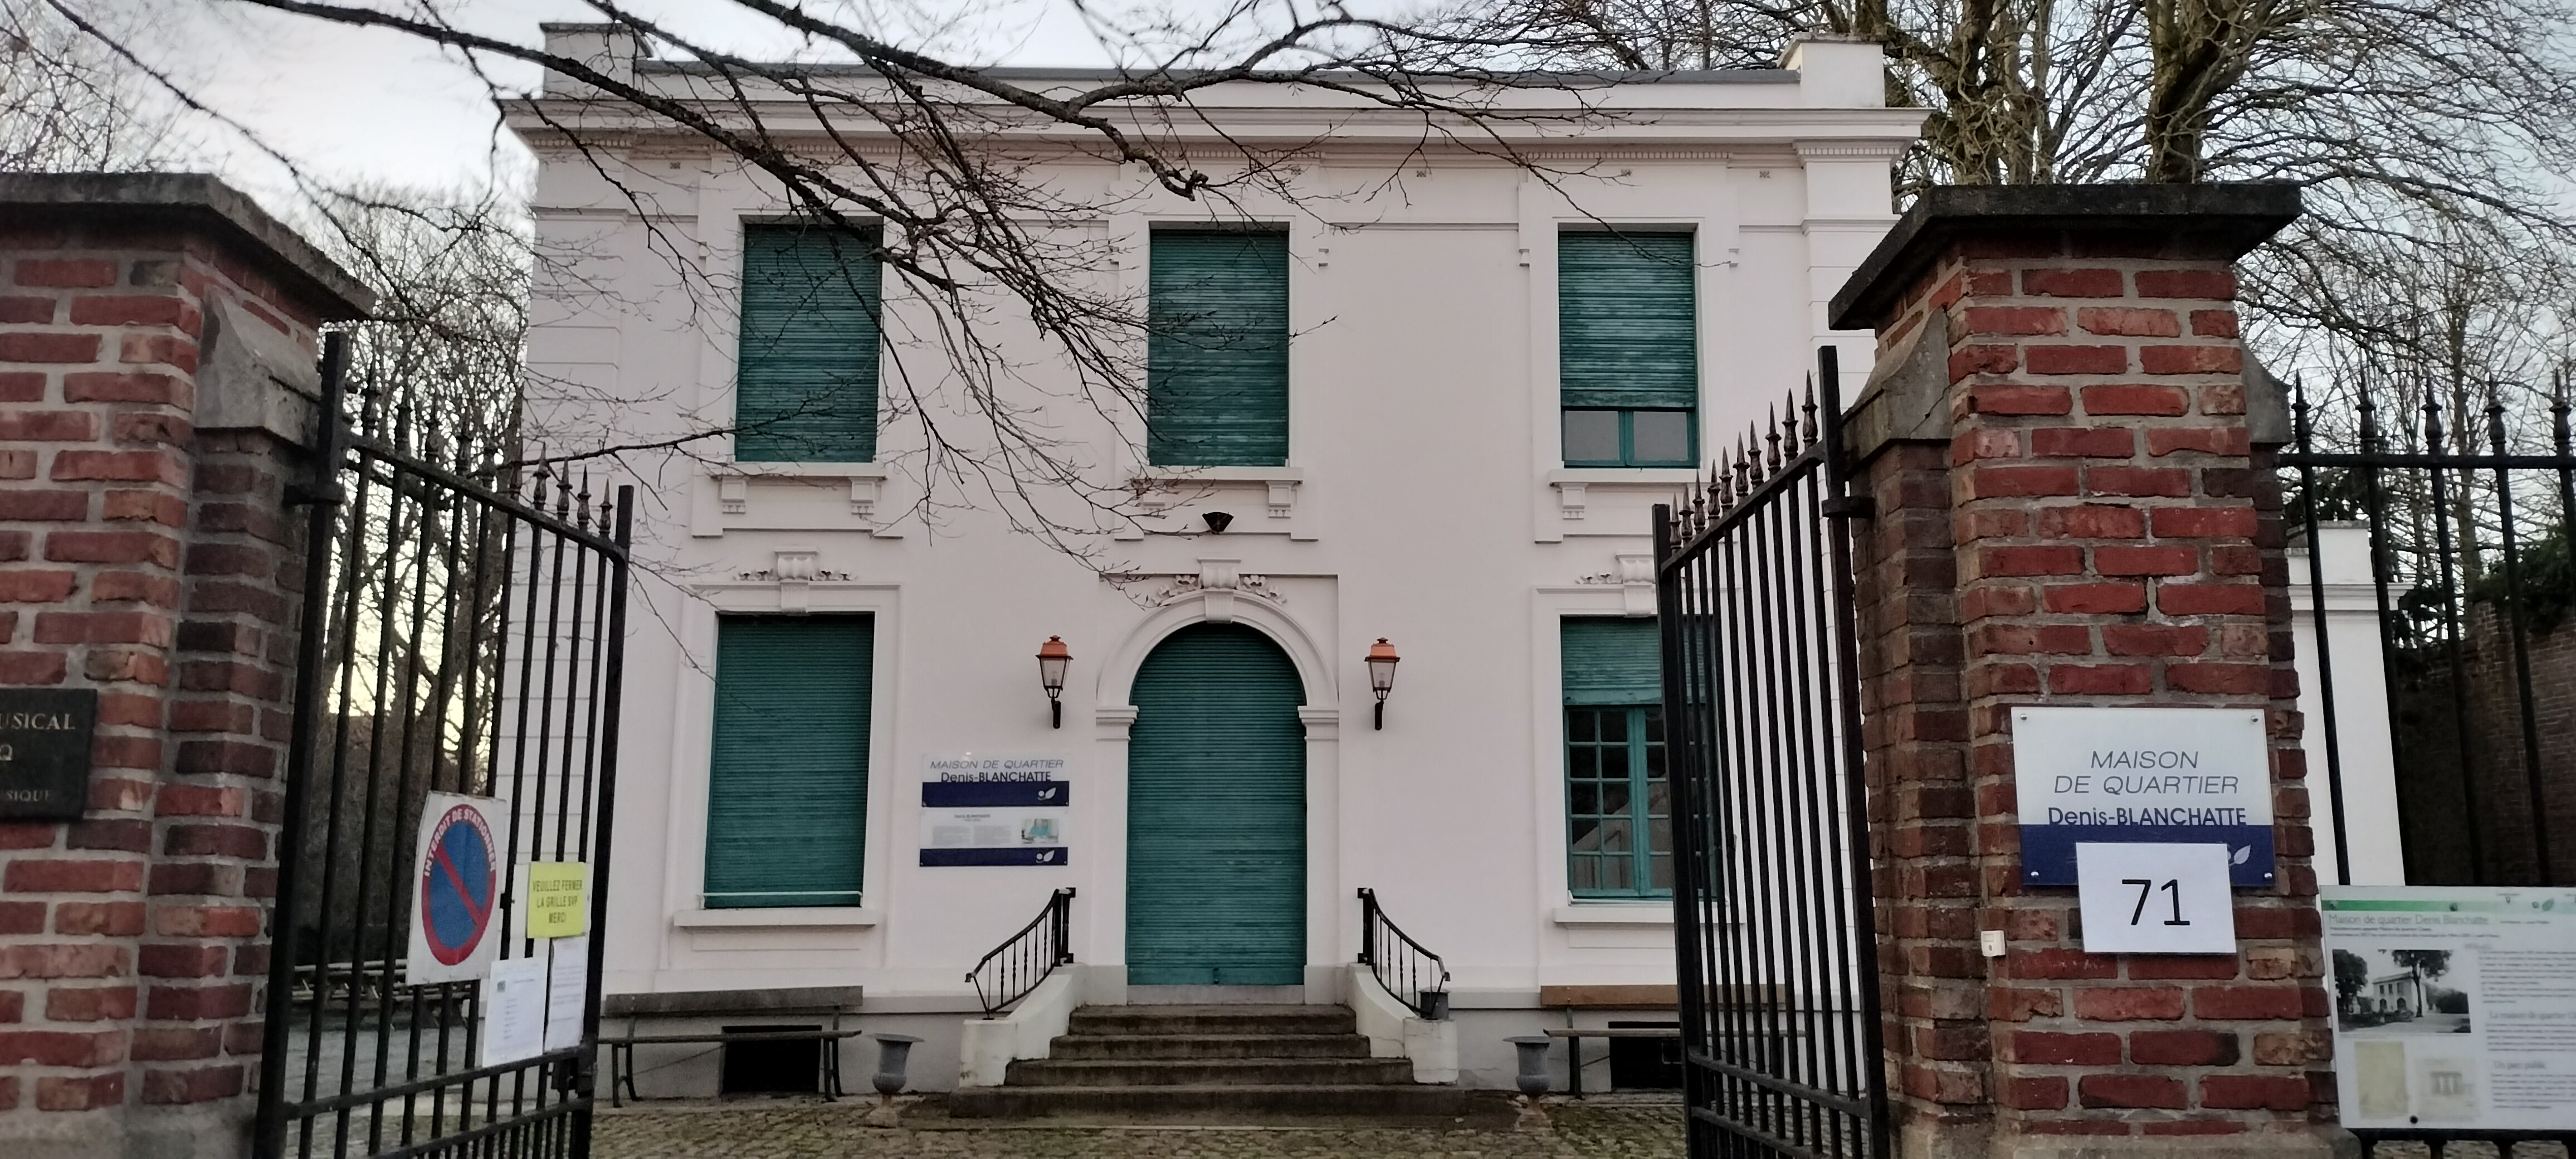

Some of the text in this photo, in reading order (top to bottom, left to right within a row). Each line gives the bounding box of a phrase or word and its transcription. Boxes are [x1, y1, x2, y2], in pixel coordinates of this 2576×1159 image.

[930, 759, 1063, 769] MAISON DE QUARTIER
[2091, 751, 2198, 769] MAISON
[941, 771, 1051, 782] Denis-BLANCHATTE
[2054, 776, 2238, 795] DE QUARTIER
[2048, 807, 2246, 826] Denis-BLANCHATTE
[425, 809, 496, 876] INTERDIT DE STATIONNER
[533, 880, 582, 892] VEUILLEZ FERMER
[536, 895, 578, 908] LA GRILLE SVP
[2121, 879, 2190, 926] 71
[549, 912, 566, 923] MERCI
[2329, 914, 2489, 926] Maison de quartier Denis Blanchatte
